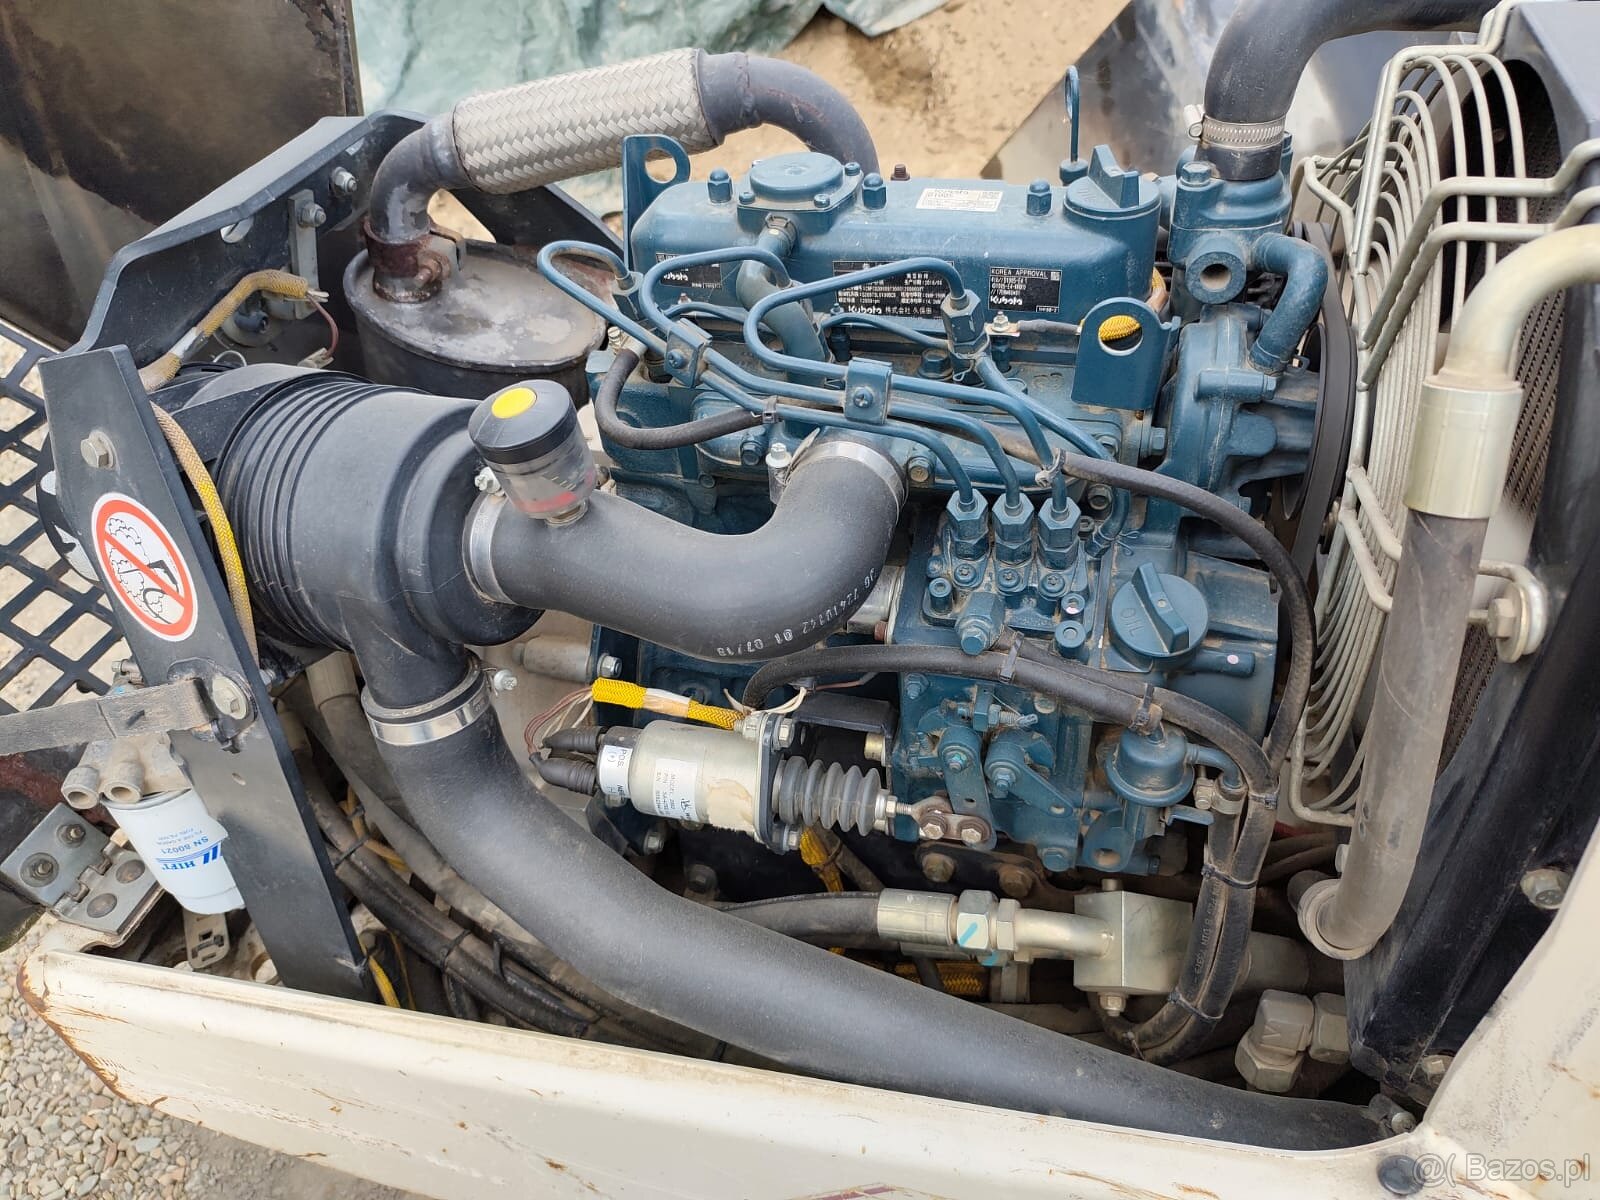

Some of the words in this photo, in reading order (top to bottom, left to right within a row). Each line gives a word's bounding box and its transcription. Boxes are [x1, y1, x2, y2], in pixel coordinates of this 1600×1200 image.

[1015, 269, 1049, 278] APPROVAL
[990, 295, 1023, 305] Kubota
[848, 304, 882, 314] Kubota
[1121, 607, 1145, 637] OIL
[193, 835, 209, 847] SN
